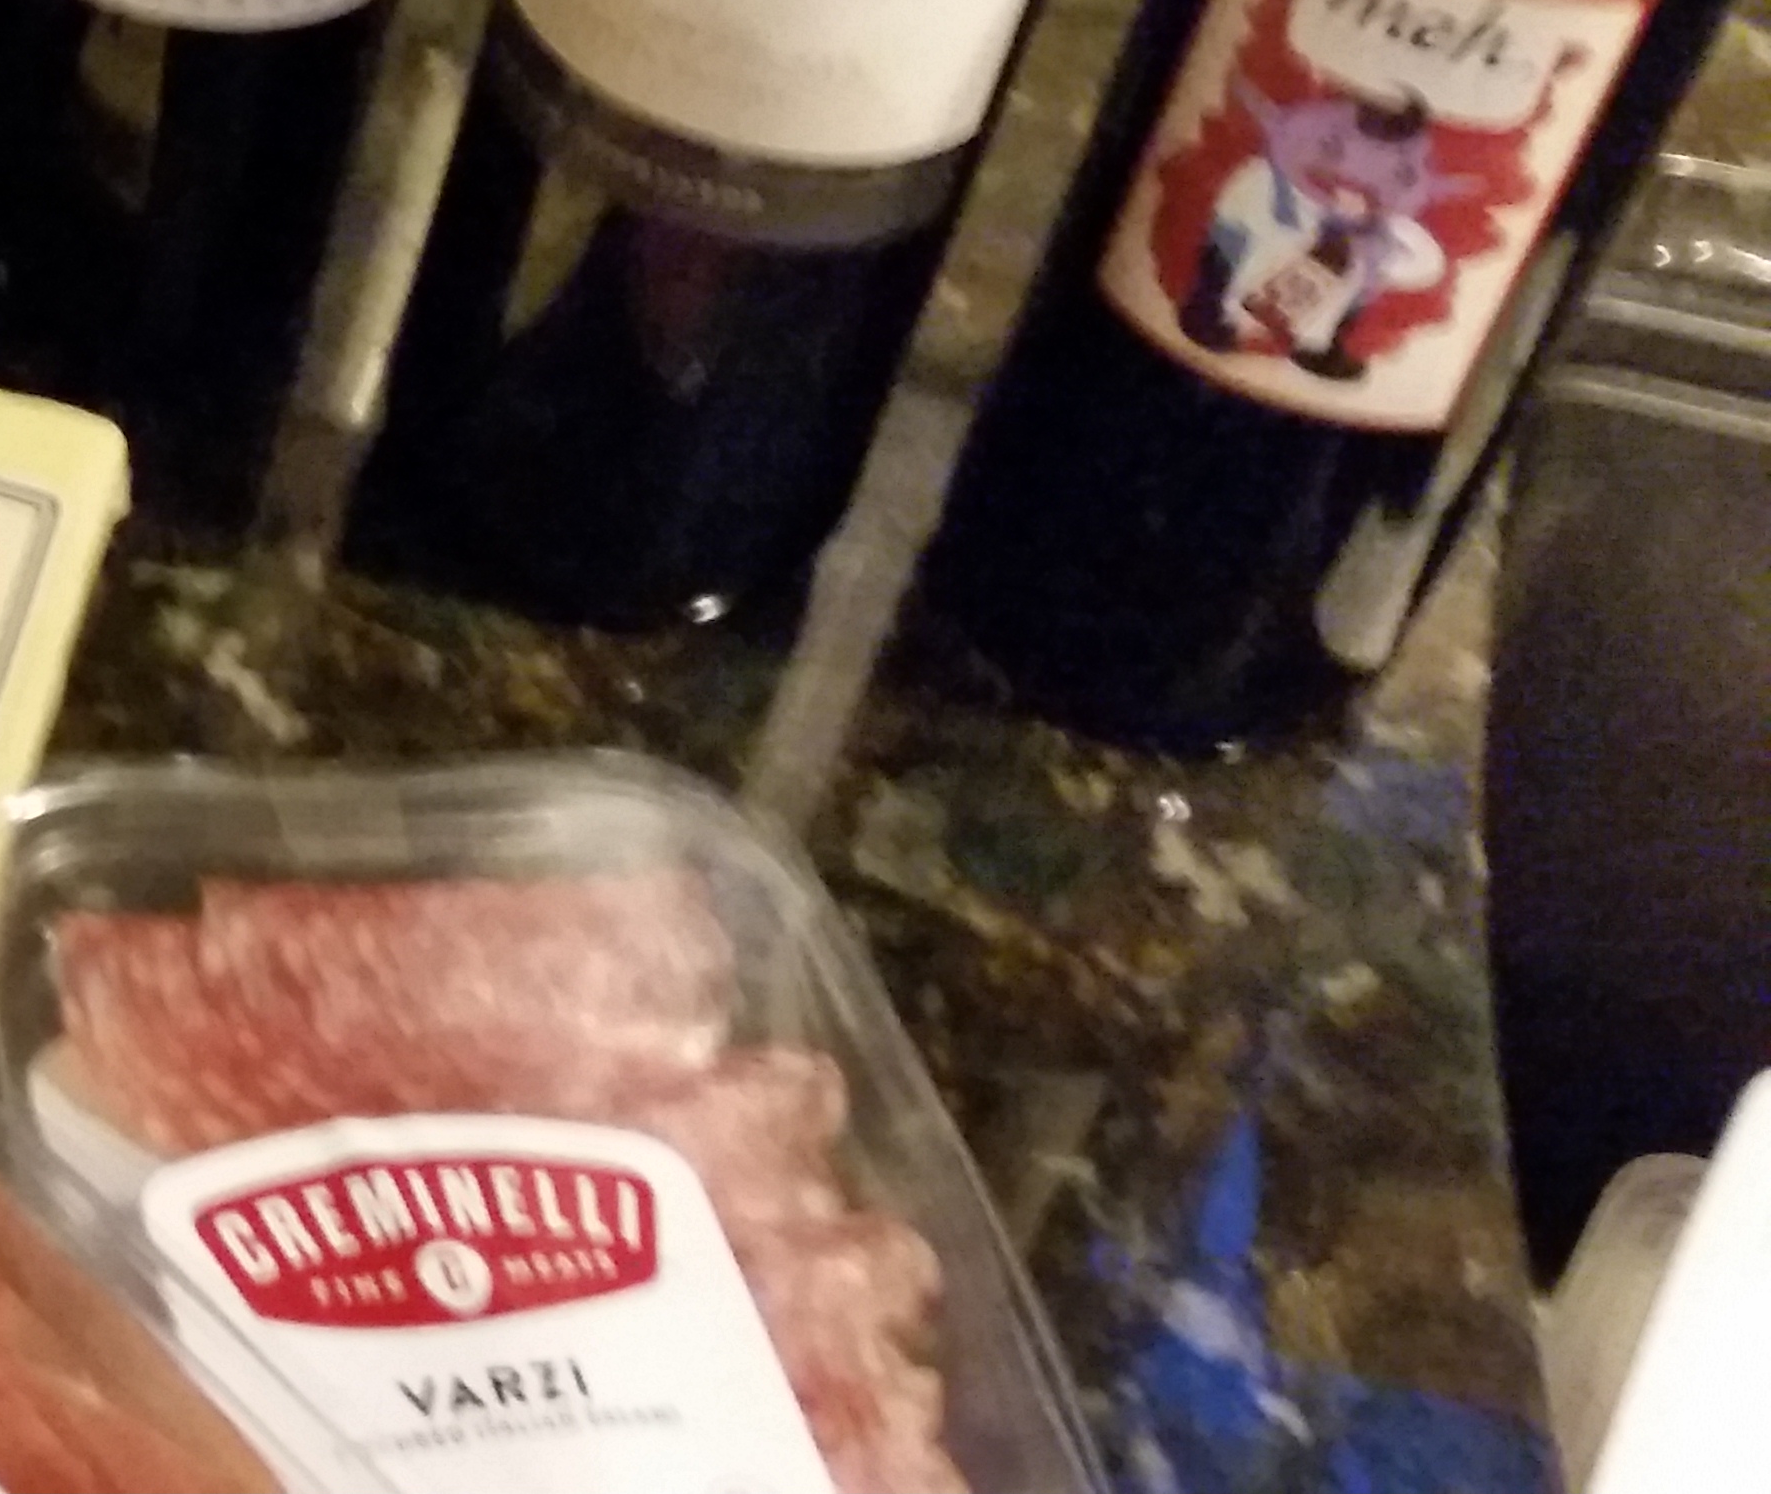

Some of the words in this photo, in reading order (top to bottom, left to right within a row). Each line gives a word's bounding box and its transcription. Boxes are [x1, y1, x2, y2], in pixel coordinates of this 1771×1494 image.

[210, 1161, 646, 1286] CREMINELLI
[309, 1272, 407, 1310] FINE
[500, 1247, 620, 1287] MEATS
[395, 1354, 590, 1417] VARZI
